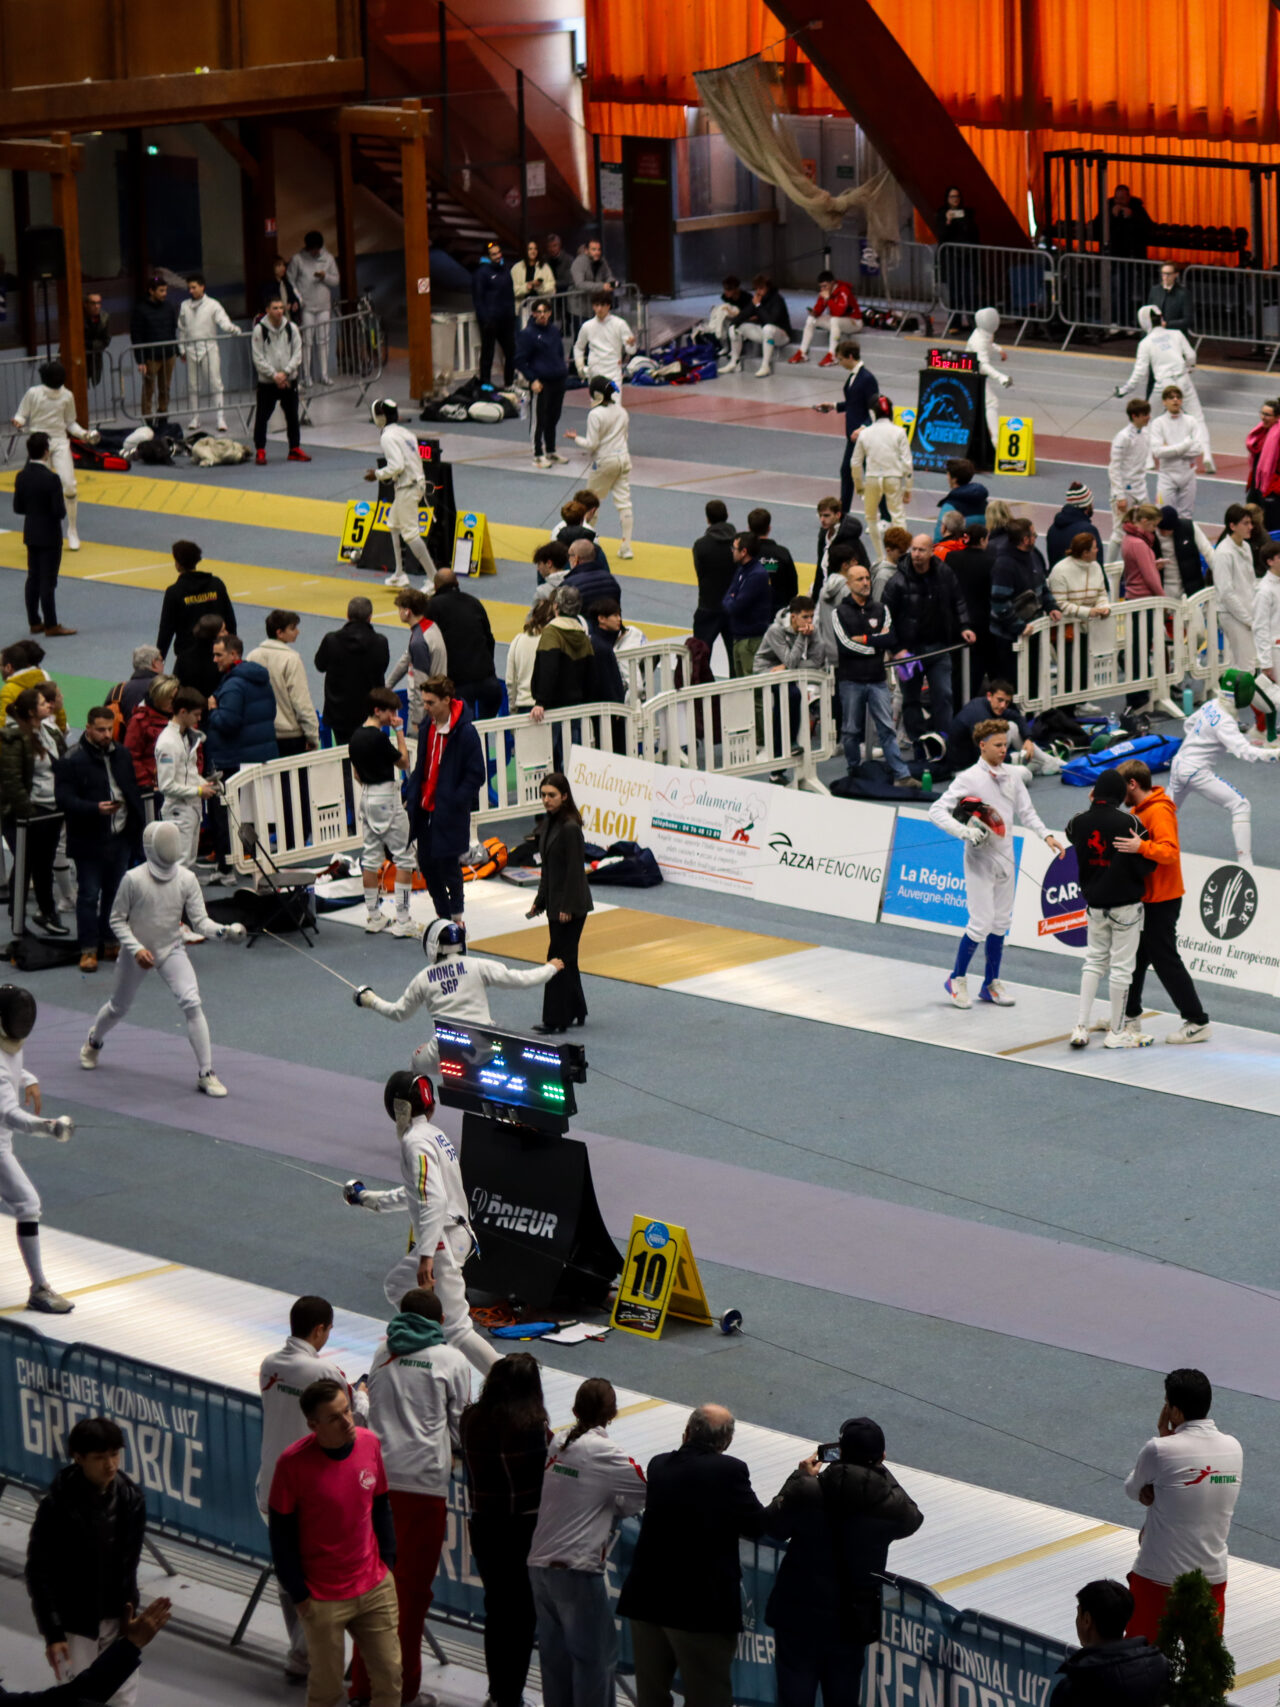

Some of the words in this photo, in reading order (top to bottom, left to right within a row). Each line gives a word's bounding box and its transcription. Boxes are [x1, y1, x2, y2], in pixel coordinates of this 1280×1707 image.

[1008, 433, 1020, 458] 8
[351, 518, 365, 543] 5
[184, 591, 218, 606] BELGIUM
[574, 762, 652, 806] Boulangerie
[656, 776, 685, 810] La
[682, 777, 742, 814] Salumeria
[780, 851, 815, 871] AZZA
[816, 858, 882, 883] FENCING
[900, 864, 917, 882] La
[920, 868, 967, 891] Région
[898, 884, 968, 908] Auvergne-Rhôn
[1046, 882, 1081, 904] CAR-
[1203, 880, 1218, 918] EFC
[1238, 888, 1254, 926] CEE
[427, 963, 456, 983] WONG
[456, 961, 468, 976] M.
[1190, 957, 1238, 980] d'Escrime
[440, 978, 458, 996] SGP
[484, 1200, 558, 1239] PRIEUR
[631, 1250, 668, 1301] 10
[399, 1358, 433, 1370] PORTUGAL
[16, 1357, 100, 1407] CHALLENGE
[102, 1383, 170, 1429] MONDIAL
[172, 1405, 198, 1438] U17
[277, 1383, 303, 1397] PORTUGA
[20, 1388, 204, 1508] GROBLE
[880, 1609, 934, 1660] LENGE
[938, 1634, 1014, 1696] MONDIAL
[1018, 1668, 1051, 1704] U17
